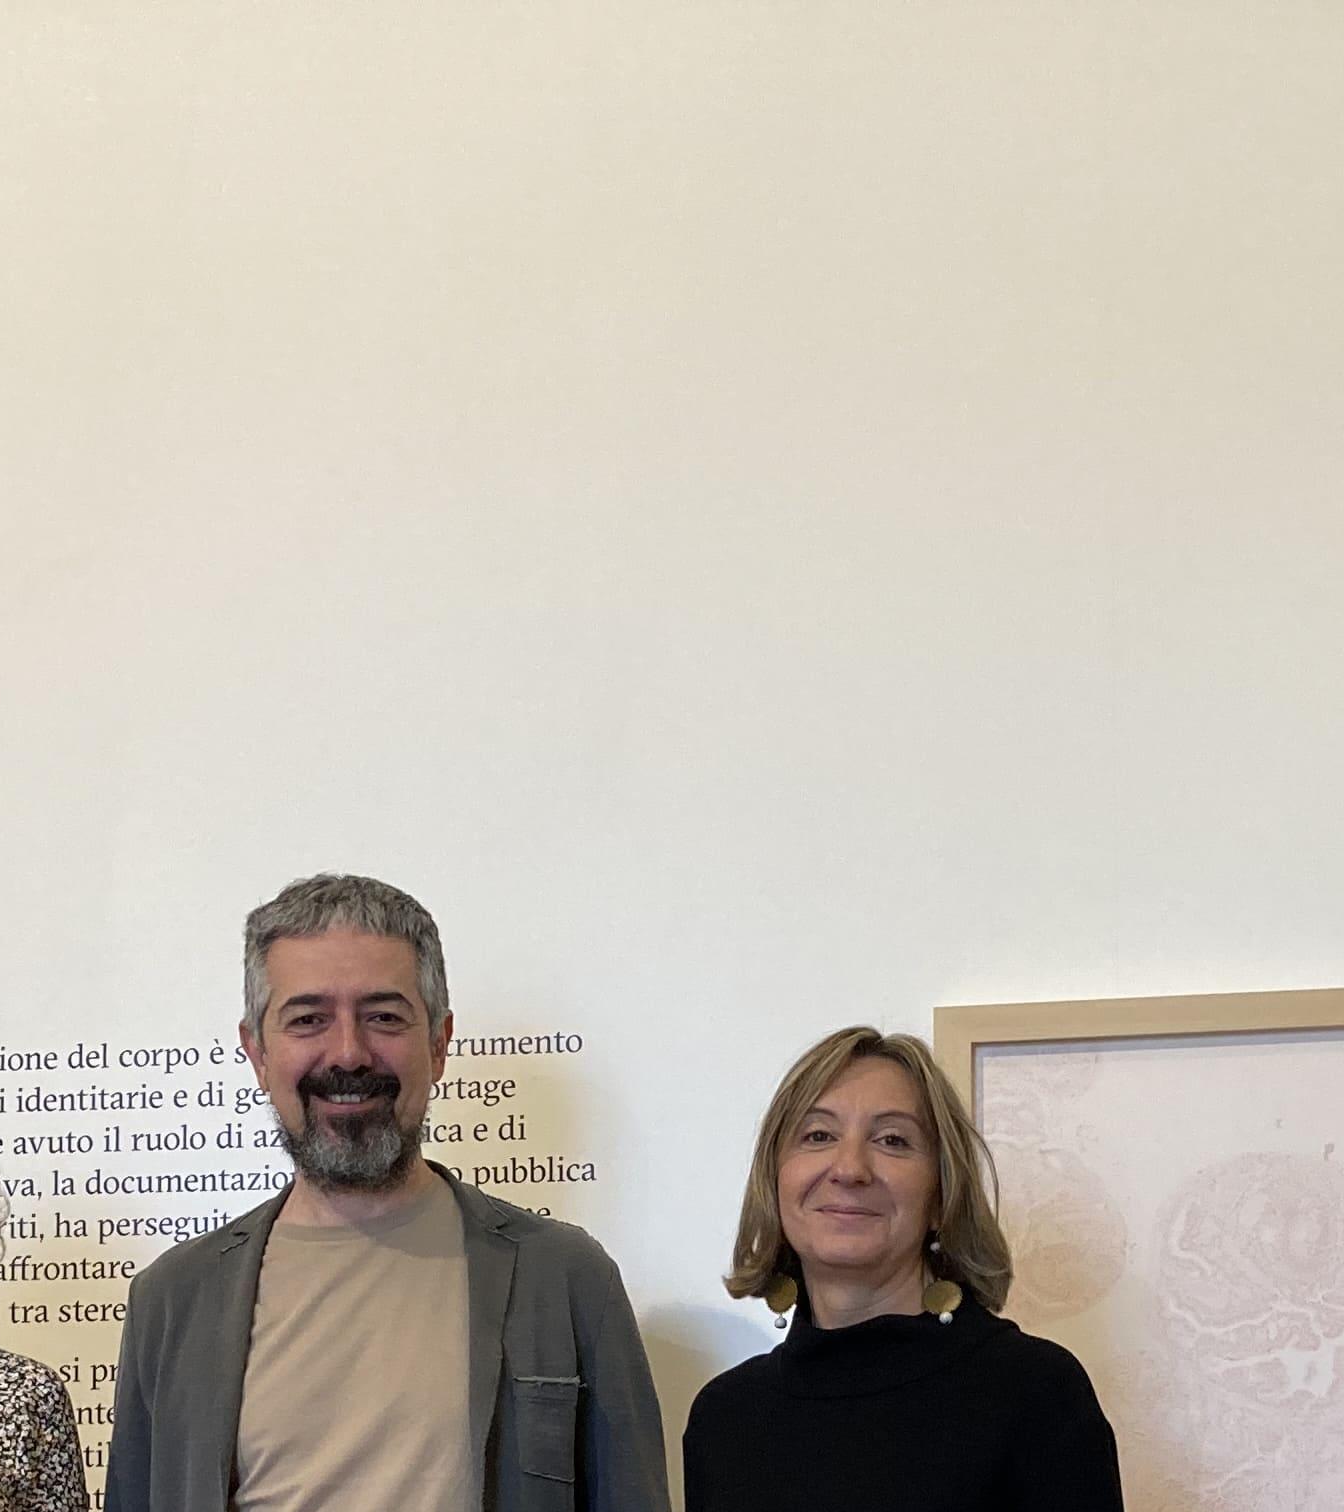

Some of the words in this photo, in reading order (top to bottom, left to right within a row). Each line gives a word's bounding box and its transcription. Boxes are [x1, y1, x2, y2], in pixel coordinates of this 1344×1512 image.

[67, 1043, 108, 1070] del
[118, 1048, 200, 1074] corpo
[210, 1039, 224, 1065] è
[446, 1031, 583, 1057] trumento
[16, 1085, 164, 1114] identitarie
[173, 1089, 189, 1108] e
[197, 1082, 224, 1108] di
[429, 1077, 516, 1106] ortage
[13, 1131, 94, 1155] avuto
[103, 1127, 121, 1154] il
[131, 1123, 207, 1152] ruolo
[217, 1123, 243, 1149] di
[473, 1120, 488, 1141] e
[498, 1115, 527, 1141] di
[52, 1170, 75, 1197] la
[472, 1156, 597, 1187] pubblica
[54, 1211, 88, 1239] ha
[97, 1209, 232, 1245] perseguit
[10, 1301, 49, 1324] tra
[58, 1299, 127, 1323] stere
[59, 1356, 80, 1382] si
